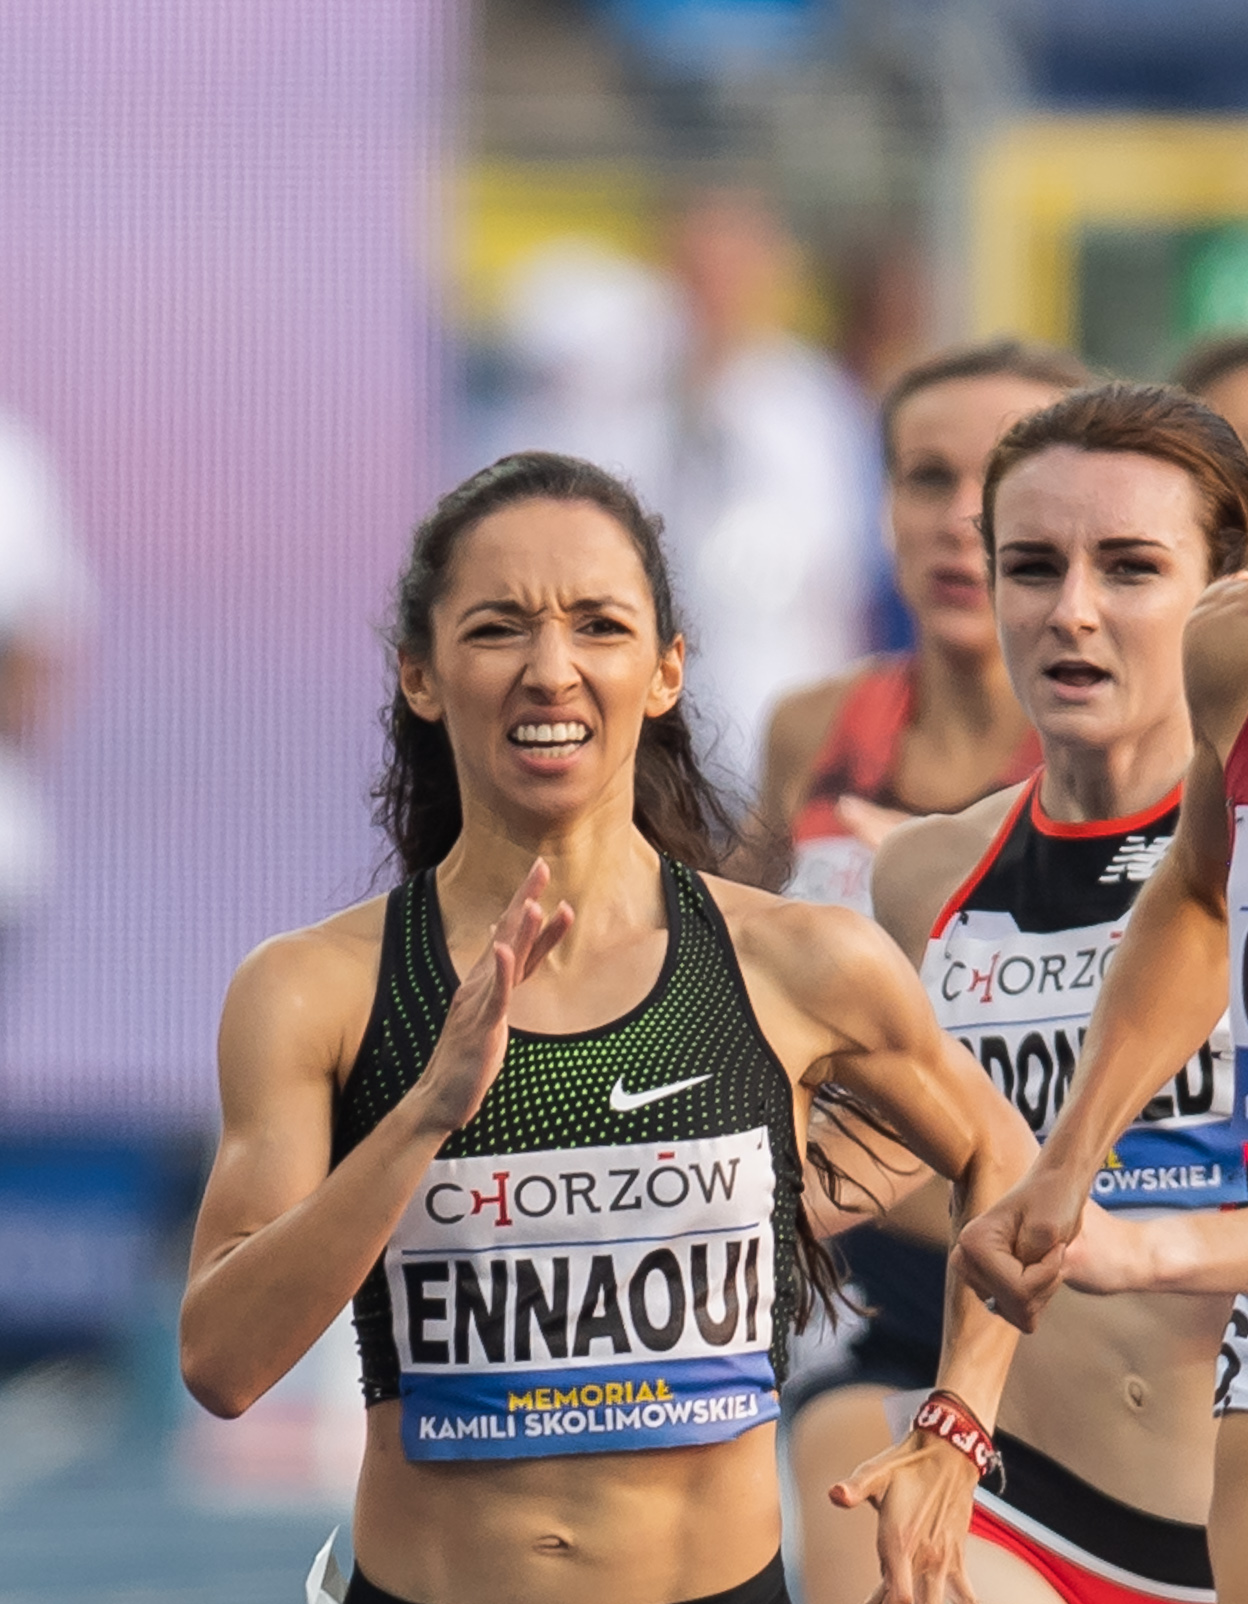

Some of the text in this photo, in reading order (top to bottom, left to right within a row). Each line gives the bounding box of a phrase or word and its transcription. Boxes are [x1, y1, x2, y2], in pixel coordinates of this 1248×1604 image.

[402, 1237, 760, 1365] ENNAOUI
[419, 1394, 759, 1440] KAMILI SKOLIMOWSKIEJ
[508, 1378, 674, 1412] MEMORIAŁ
